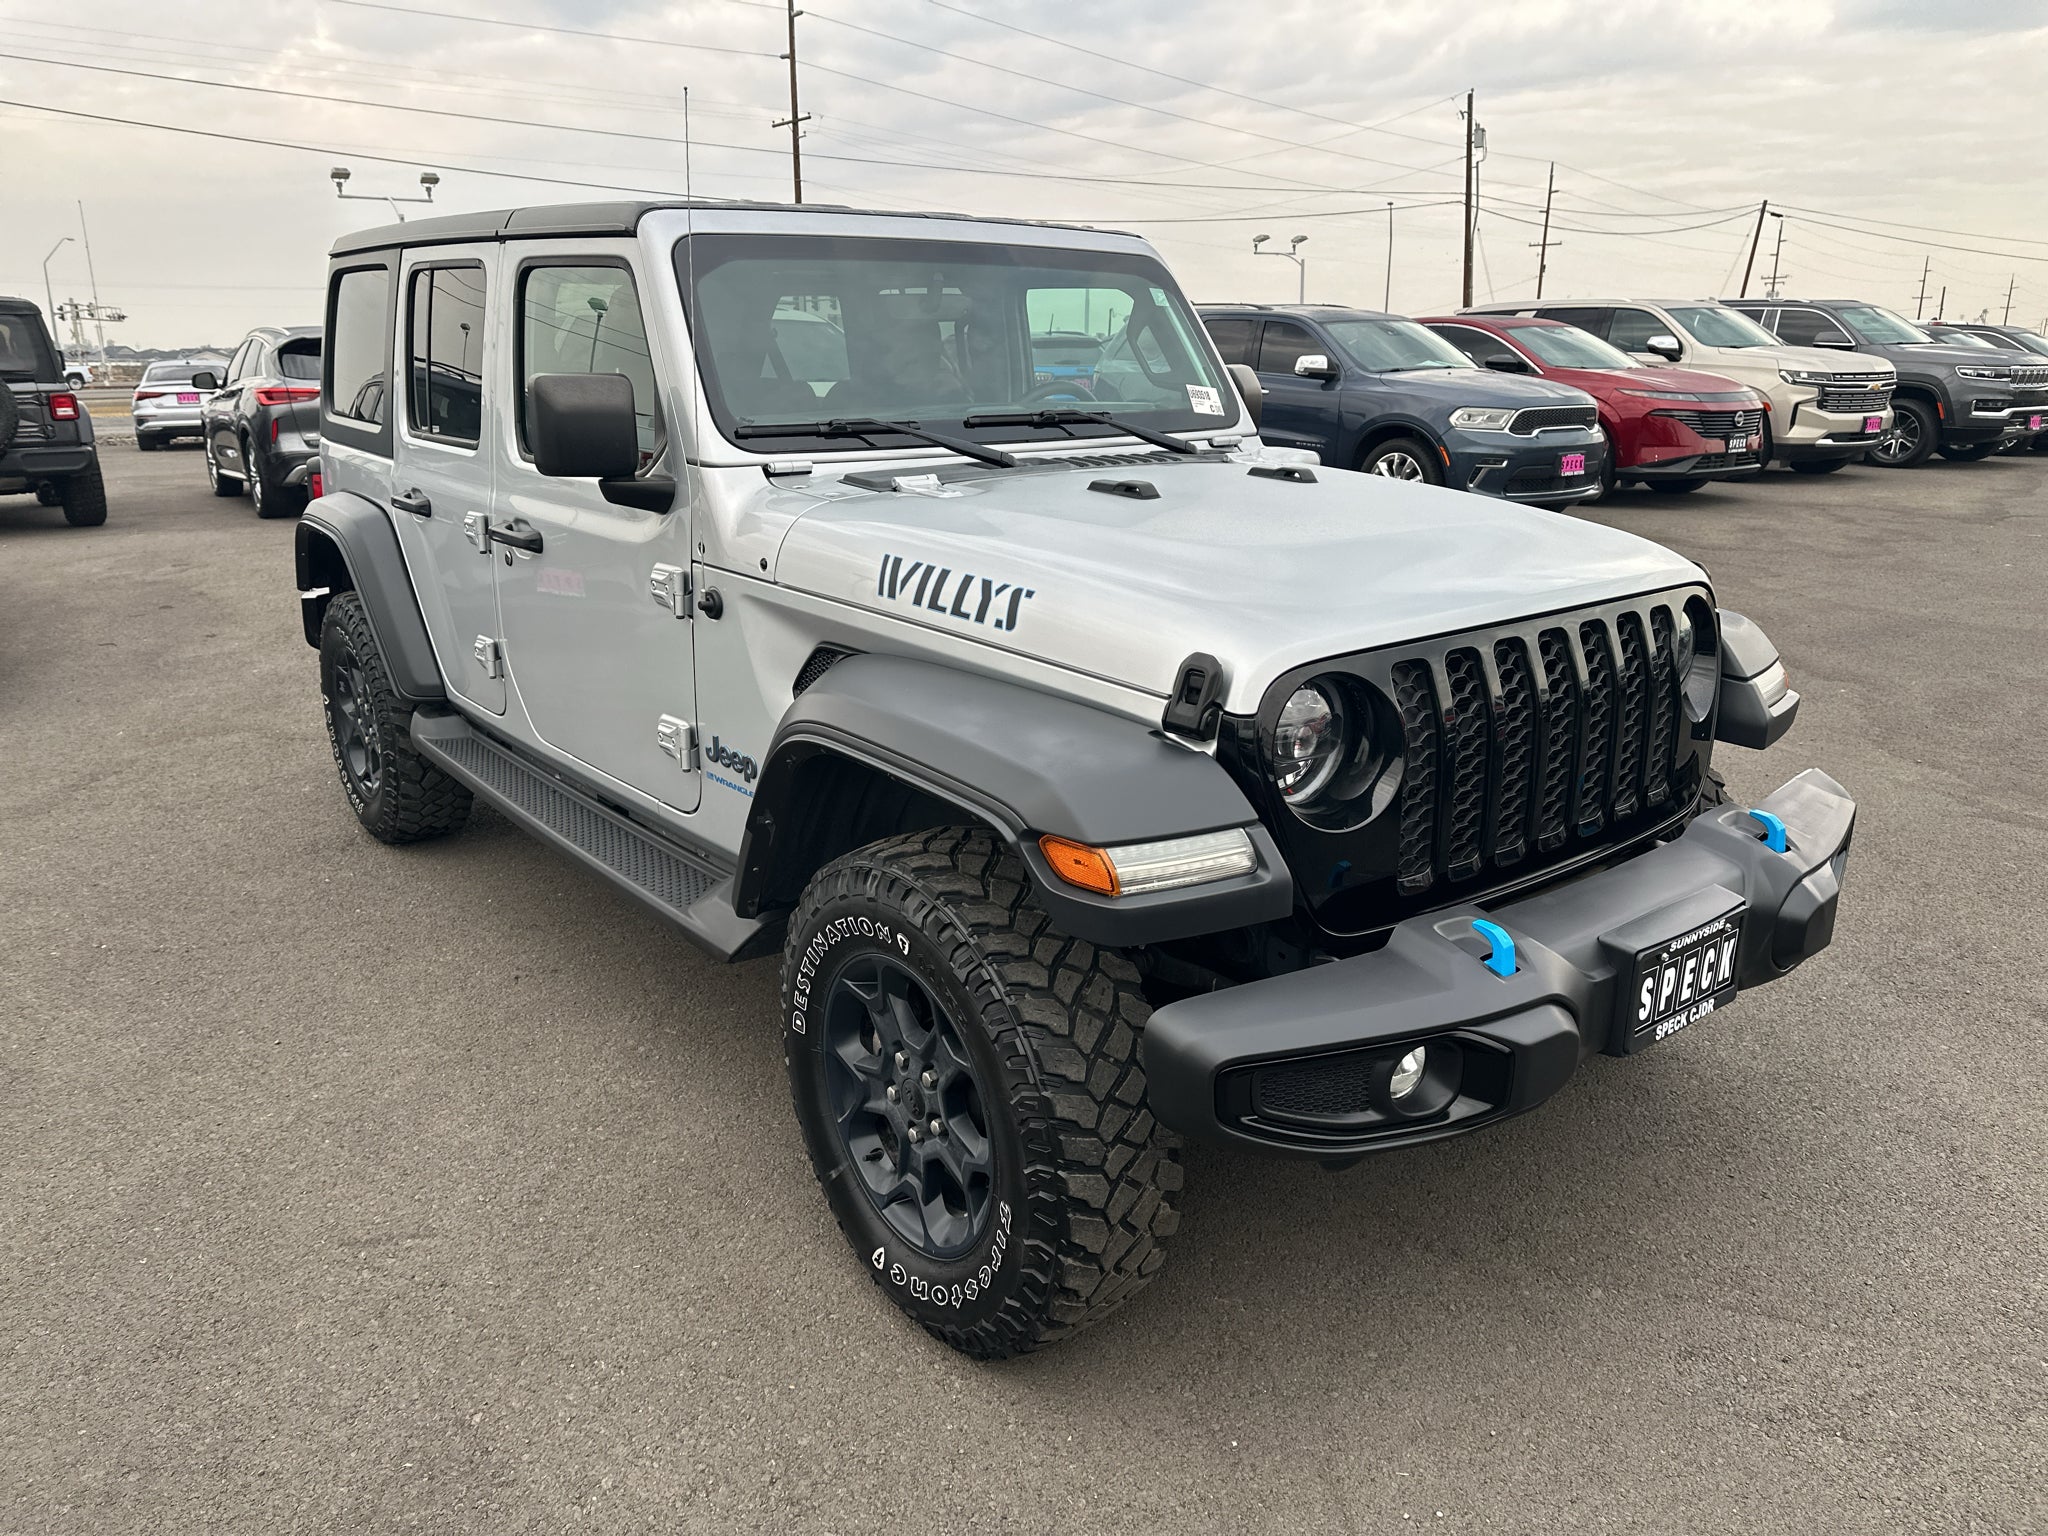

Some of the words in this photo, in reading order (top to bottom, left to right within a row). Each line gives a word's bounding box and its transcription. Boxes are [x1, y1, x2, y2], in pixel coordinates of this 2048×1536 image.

[1561, 459, 1583, 470] SPECK
[878, 553, 1036, 632] WILLYS
[705, 735, 758, 784] Jeep
[714, 774, 755, 798] WRANGLE
[1669, 918, 1726, 952] SUNNYSIDE
[792, 916, 892, 1035] DESTINATION
[1638, 937, 1736, 1021] SPECK
[1655, 1012, 1688, 1041] SPECK
[1689, 998, 1715, 1024] CJDR
[890, 1201, 1012, 1310] Firestone
